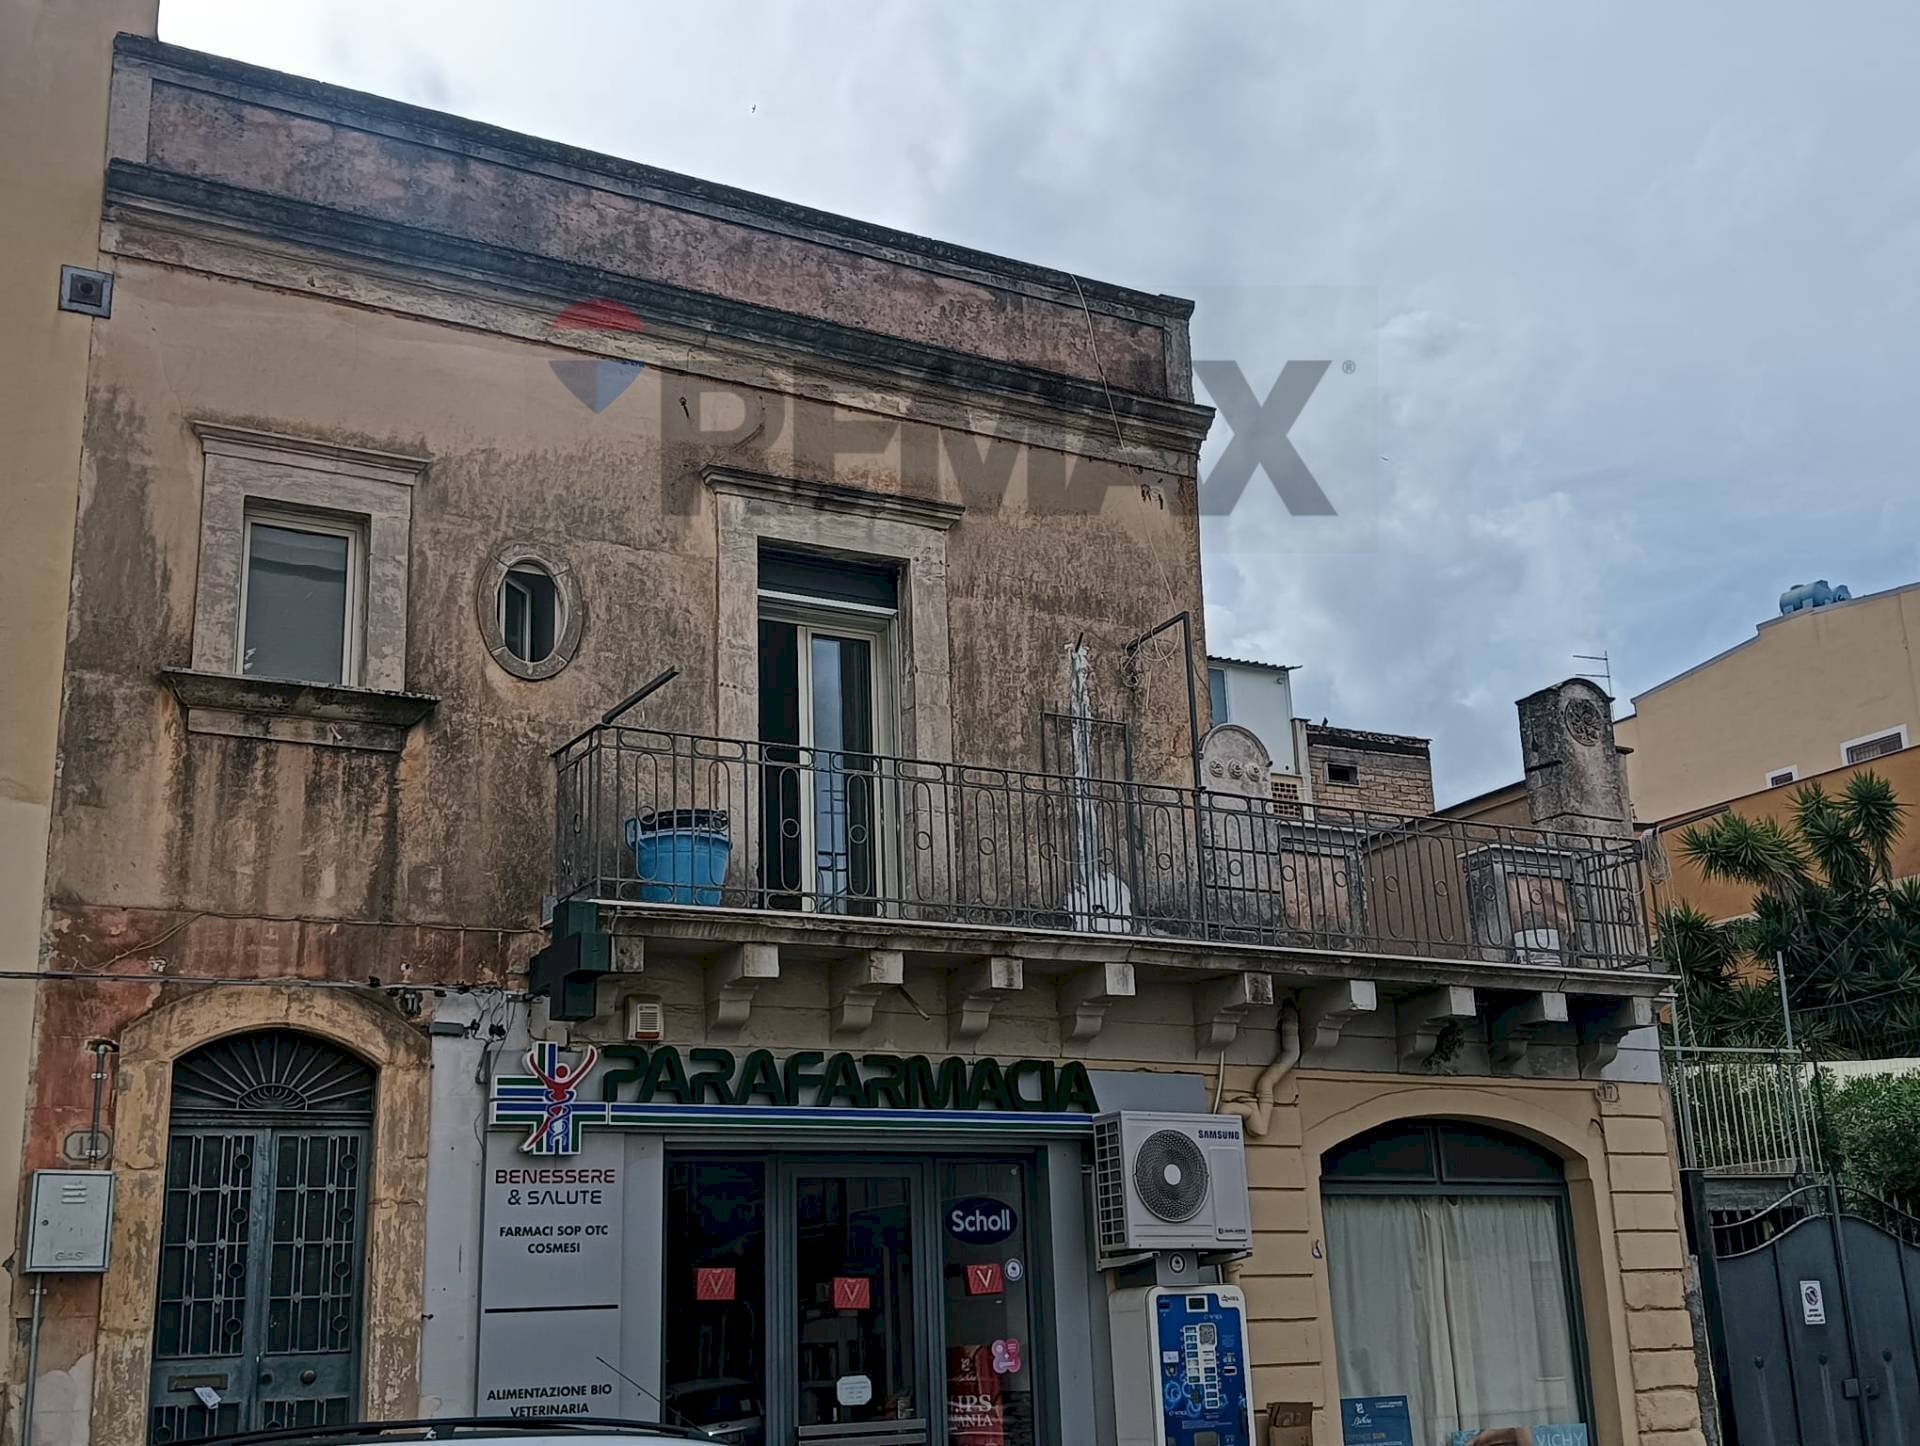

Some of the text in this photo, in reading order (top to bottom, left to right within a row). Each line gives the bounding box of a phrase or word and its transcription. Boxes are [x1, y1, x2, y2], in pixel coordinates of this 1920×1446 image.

[601, 1044, 1100, 1114] PARAFARMACIA
[1198, 1129, 1240, 1140] SAMSUNG
[495, 1169, 616, 1184] BENESSERE
[507, 1188, 603, 1206] & SALUTE
[951, 1208, 1011, 1232] Scholl
[499, 1225, 609, 1237] FARMACI SOP OTC
[527, 1242, 581, 1254] COSMESI
[486, 1384, 613, 1401] ALIMENTAZIONE BIO
[510, 1403, 590, 1418] VETERINARIA
[1535, 1431, 1584, 1446] VICHY
